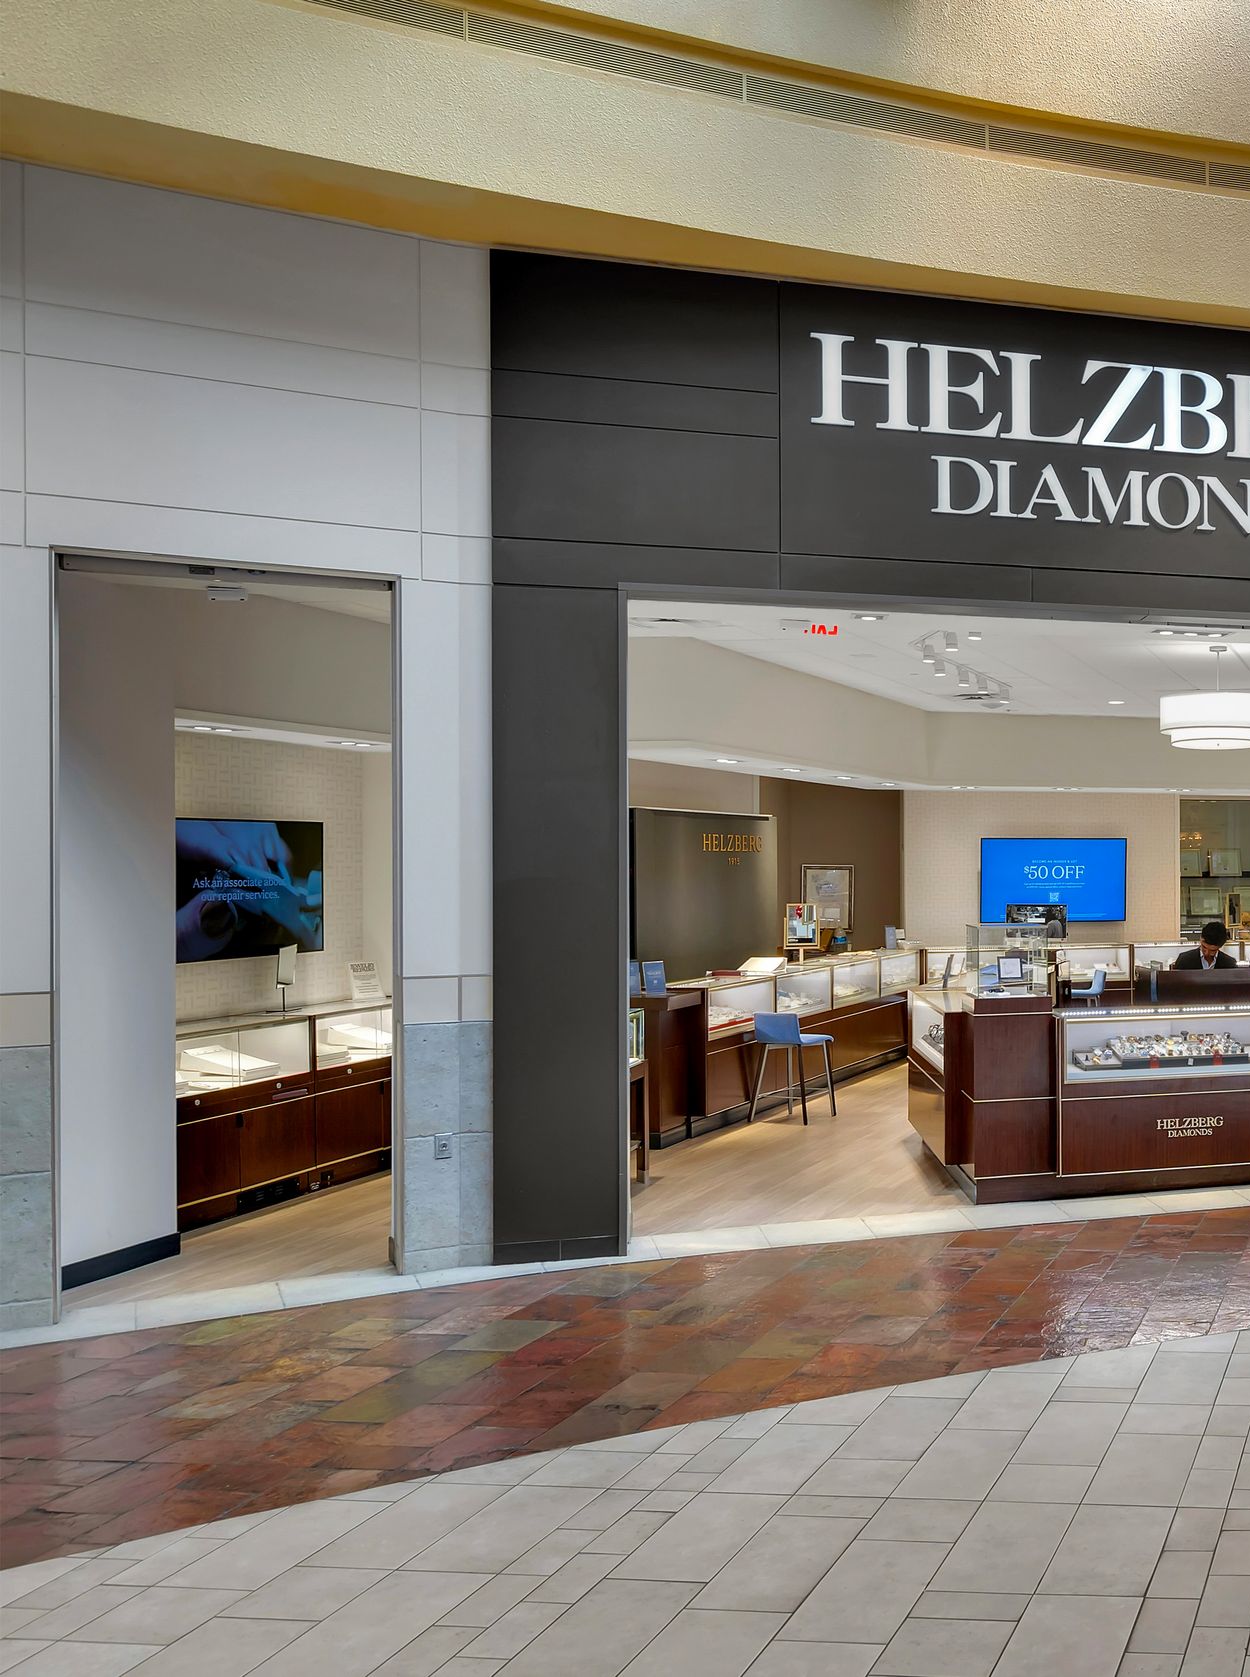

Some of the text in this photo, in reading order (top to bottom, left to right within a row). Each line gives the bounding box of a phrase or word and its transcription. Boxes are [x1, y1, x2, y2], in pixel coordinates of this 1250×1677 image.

[702, 833, 763, 853] HELZBERG
[1023, 865, 1085, 880] $50 OFF
[193, 877, 211, 889] Ask
[224, 878, 263, 888] associate
[264, 878, 282, 887] abo
[218, 891, 243, 903] repair
[244, 889, 280, 900] services.
[1156, 1115, 1224, 1130] HELZBERG
[1168, 1128, 1213, 1138] DIAMONDS
